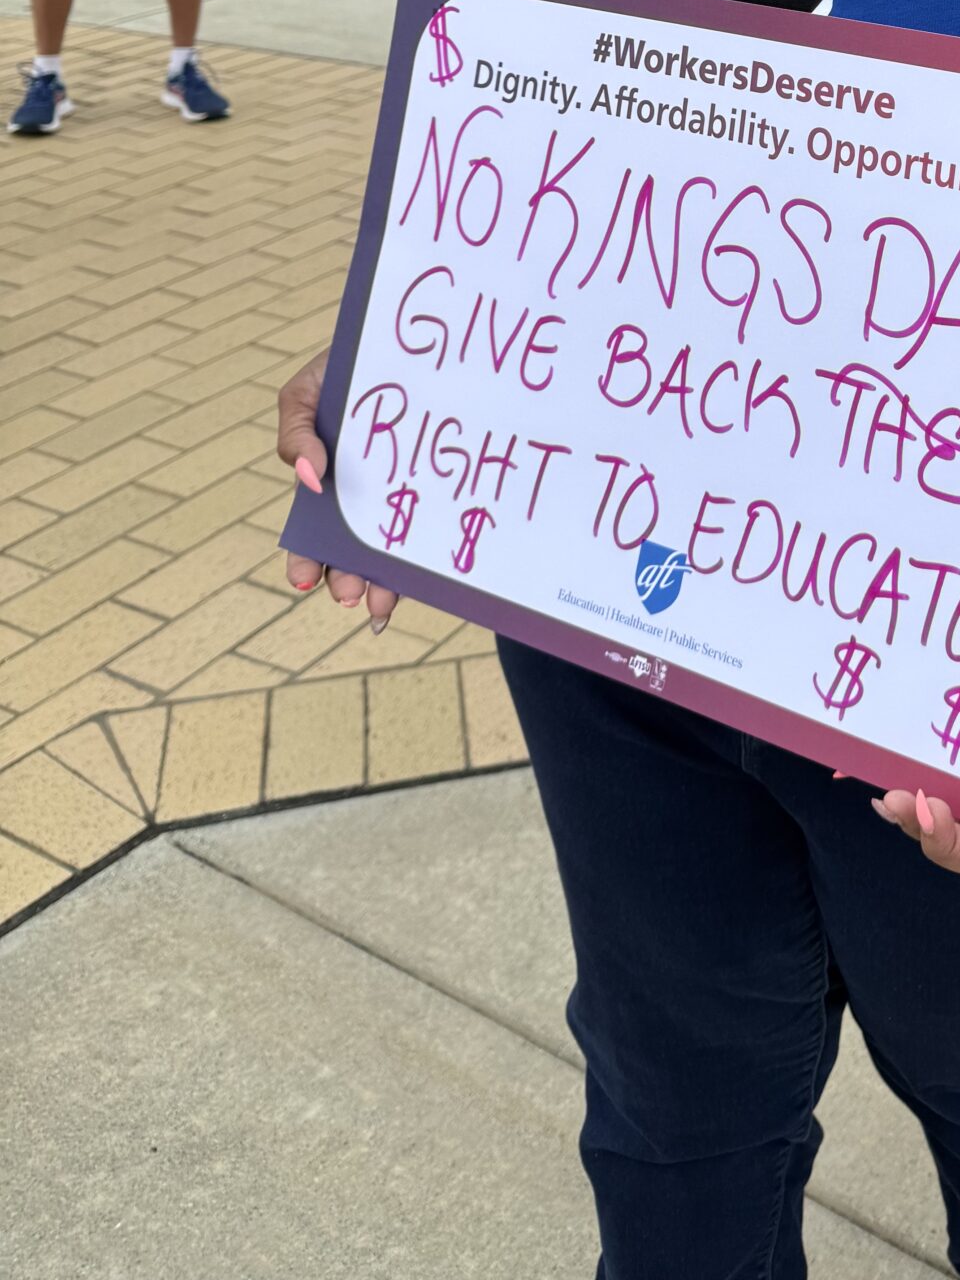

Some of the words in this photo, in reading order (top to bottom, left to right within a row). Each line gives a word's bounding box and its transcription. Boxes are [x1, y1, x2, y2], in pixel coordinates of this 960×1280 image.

[473, 59, 583, 112] Dignity.
[590, 82, 796, 160] Affordability.
[592, 32, 897, 120] #WorkersDeserve
[400, 105, 503, 246] NO
[517, 131, 832, 344] KINGS
[395, 266, 565, 392] GIVE
[599, 324, 801, 458] BACK
[351, 382, 571, 521] RIGHT
[594, 454, 659, 550] TO
[637, 551, 692, 601] aft
[557, 588, 605, 616] Education
[610, 606, 664, 638] Healthcare
[669, 630, 702, 652] Public
[702, 642, 744, 669] Services
